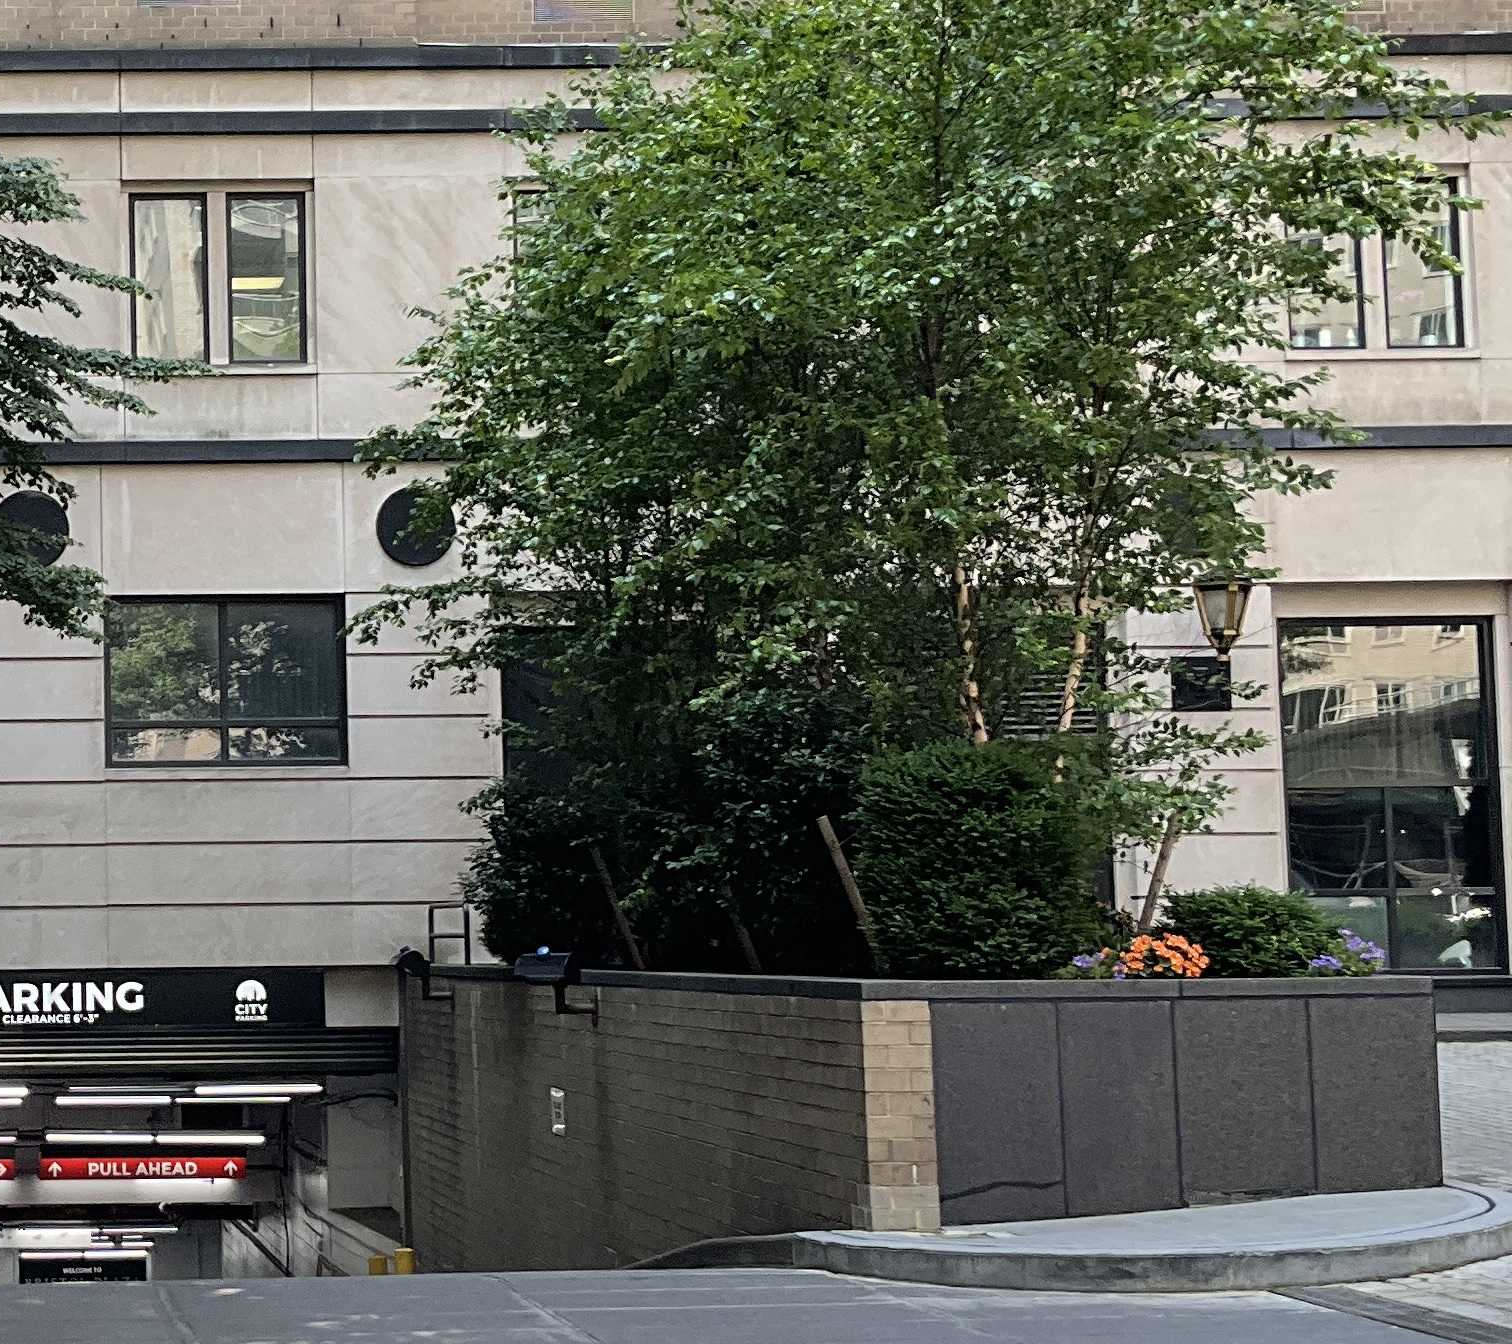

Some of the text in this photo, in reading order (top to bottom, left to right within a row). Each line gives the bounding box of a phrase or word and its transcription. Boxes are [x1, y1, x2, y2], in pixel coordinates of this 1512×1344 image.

[234, 1003, 269, 1015] CITY
[2, 1014, 71, 1025] CLEARANCE
[87, 1161, 199, 1177] PULL AHEAD
